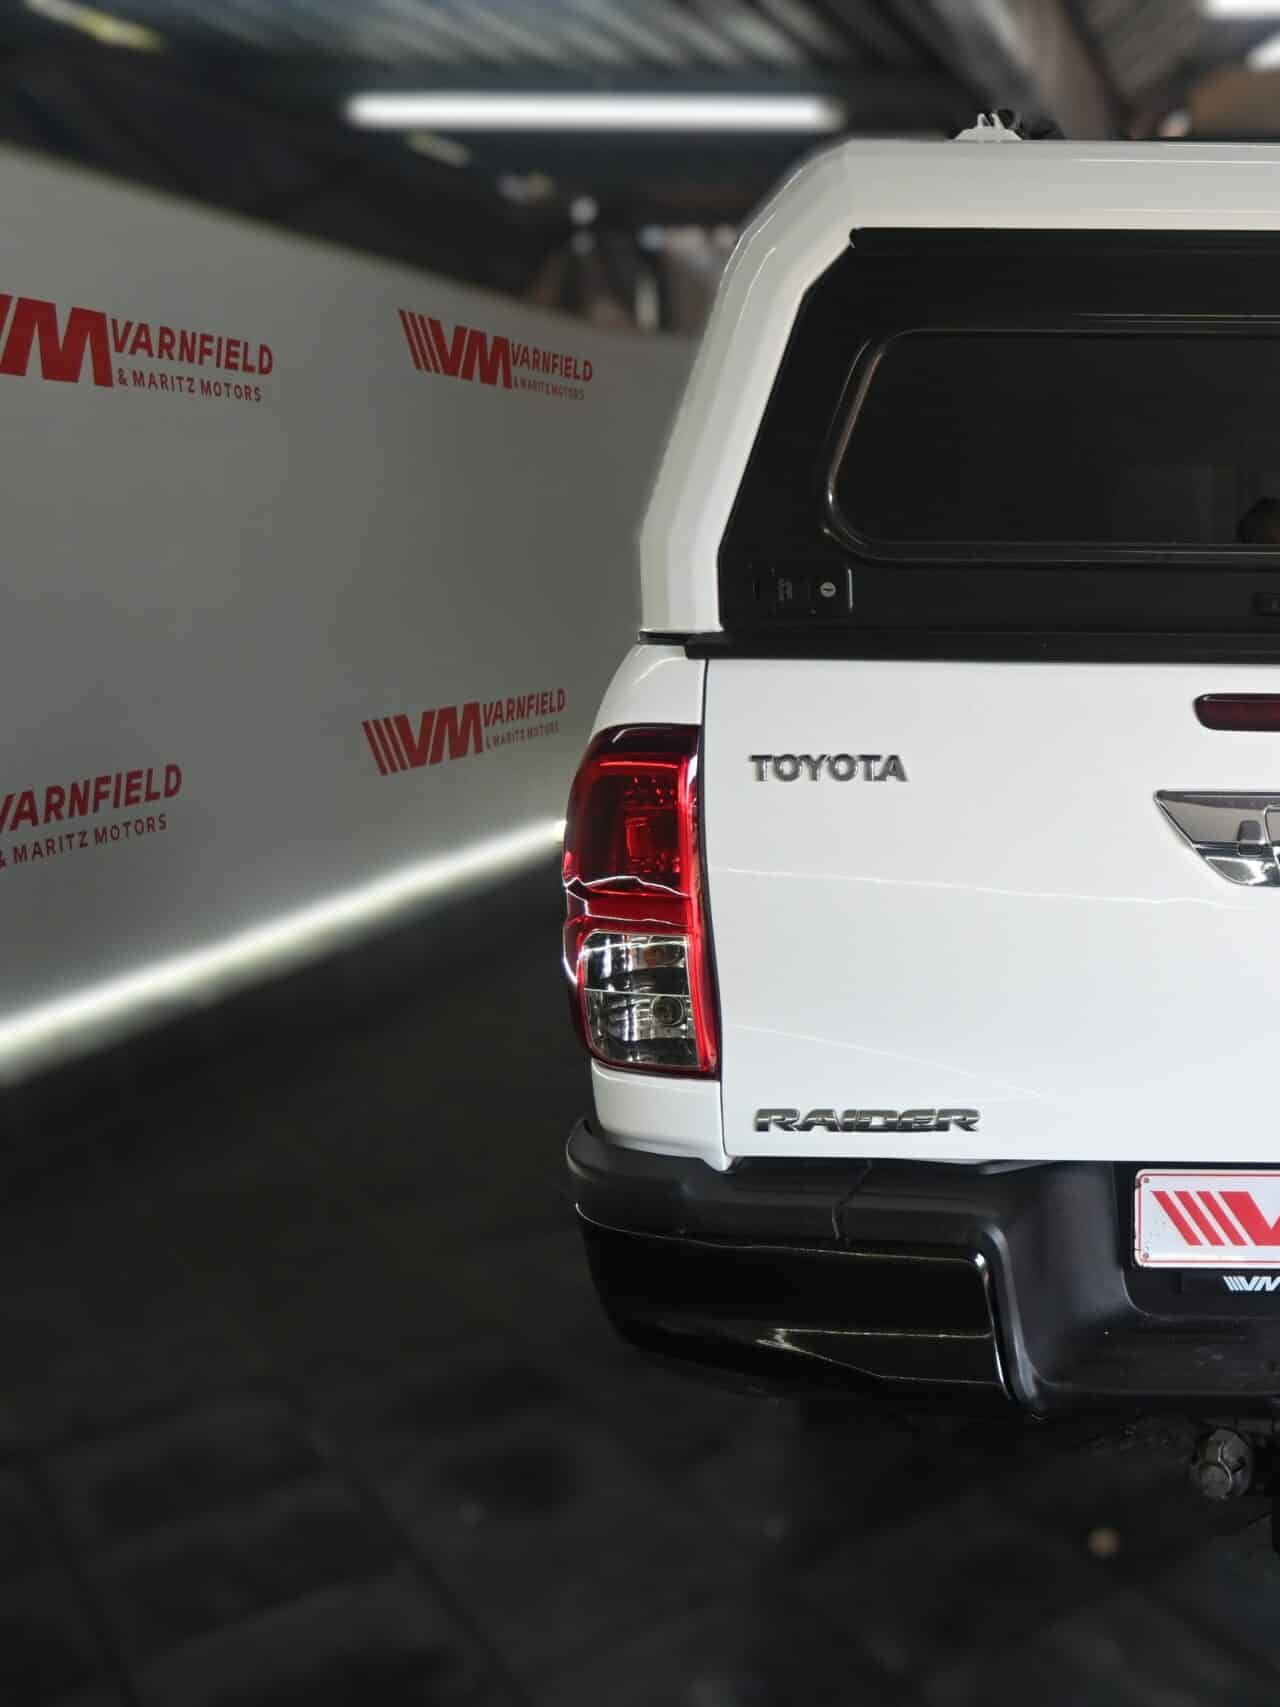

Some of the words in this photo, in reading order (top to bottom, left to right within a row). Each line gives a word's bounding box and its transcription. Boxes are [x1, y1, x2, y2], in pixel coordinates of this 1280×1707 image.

[110, 318, 274, 376] VARNFIELD
[427, 318, 513, 390] VM
[511, 341, 593, 382] VARNFIELD
[117, 368, 128, 386] &
[133, 371, 195, 394] MARITZ
[200, 379, 262, 402] MOTORS
[483, 688, 566, 728] VARNFIELD
[393, 701, 484, 768] VM
[749, 754, 909, 783] TOYOTA
[13, 830, 89, 864] MARITZ
[94, 813, 168, 846] MOTORS
[754, 1108, 981, 1133] RAIDER
